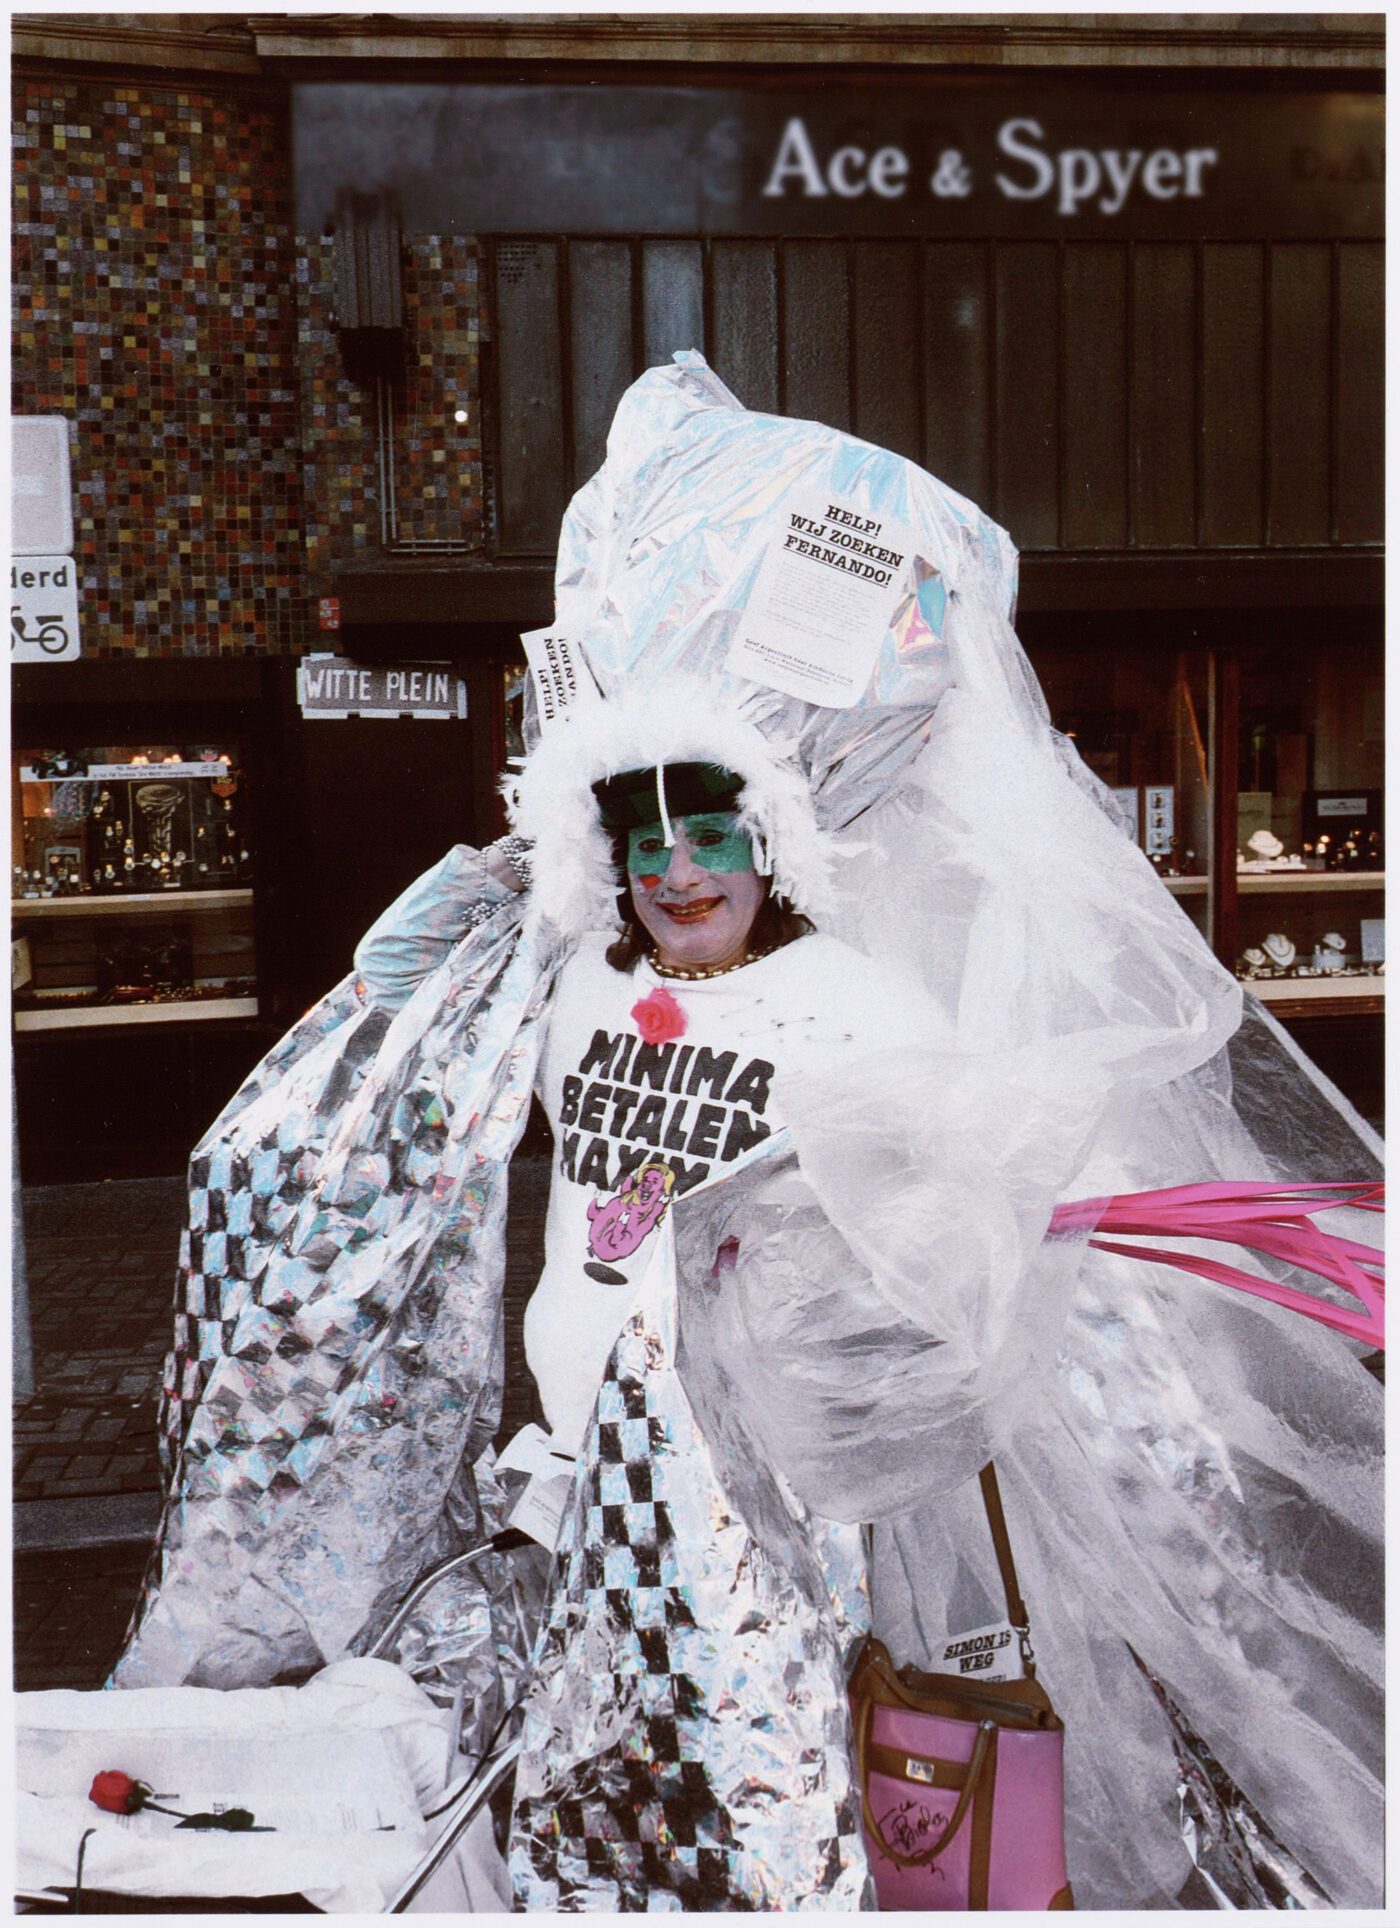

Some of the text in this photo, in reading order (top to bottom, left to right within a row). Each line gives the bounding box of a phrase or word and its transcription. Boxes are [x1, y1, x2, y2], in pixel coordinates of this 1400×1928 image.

[763, 118, 909, 198] Ace
[931, 149, 972, 198] &
[996, 118, 1218, 215] Spyer
[791, 513, 904, 567] WIJ ZOEKEN
[825, 504, 882, 536] HELP!
[784, 534, 892, 585] FERNANDO!
[303, 669, 448, 703] WITTE PLEIN
[558, 638, 576, 697] ANDO!
[578, 1029, 775, 1115] MINIMA
[559, 1075, 771, 1162] BETALEN
[561, 1130, 710, 1198] MAXM
[944, 1629, 1012, 1659] SIMON IS
[960, 1652, 994, 1672] WEG
